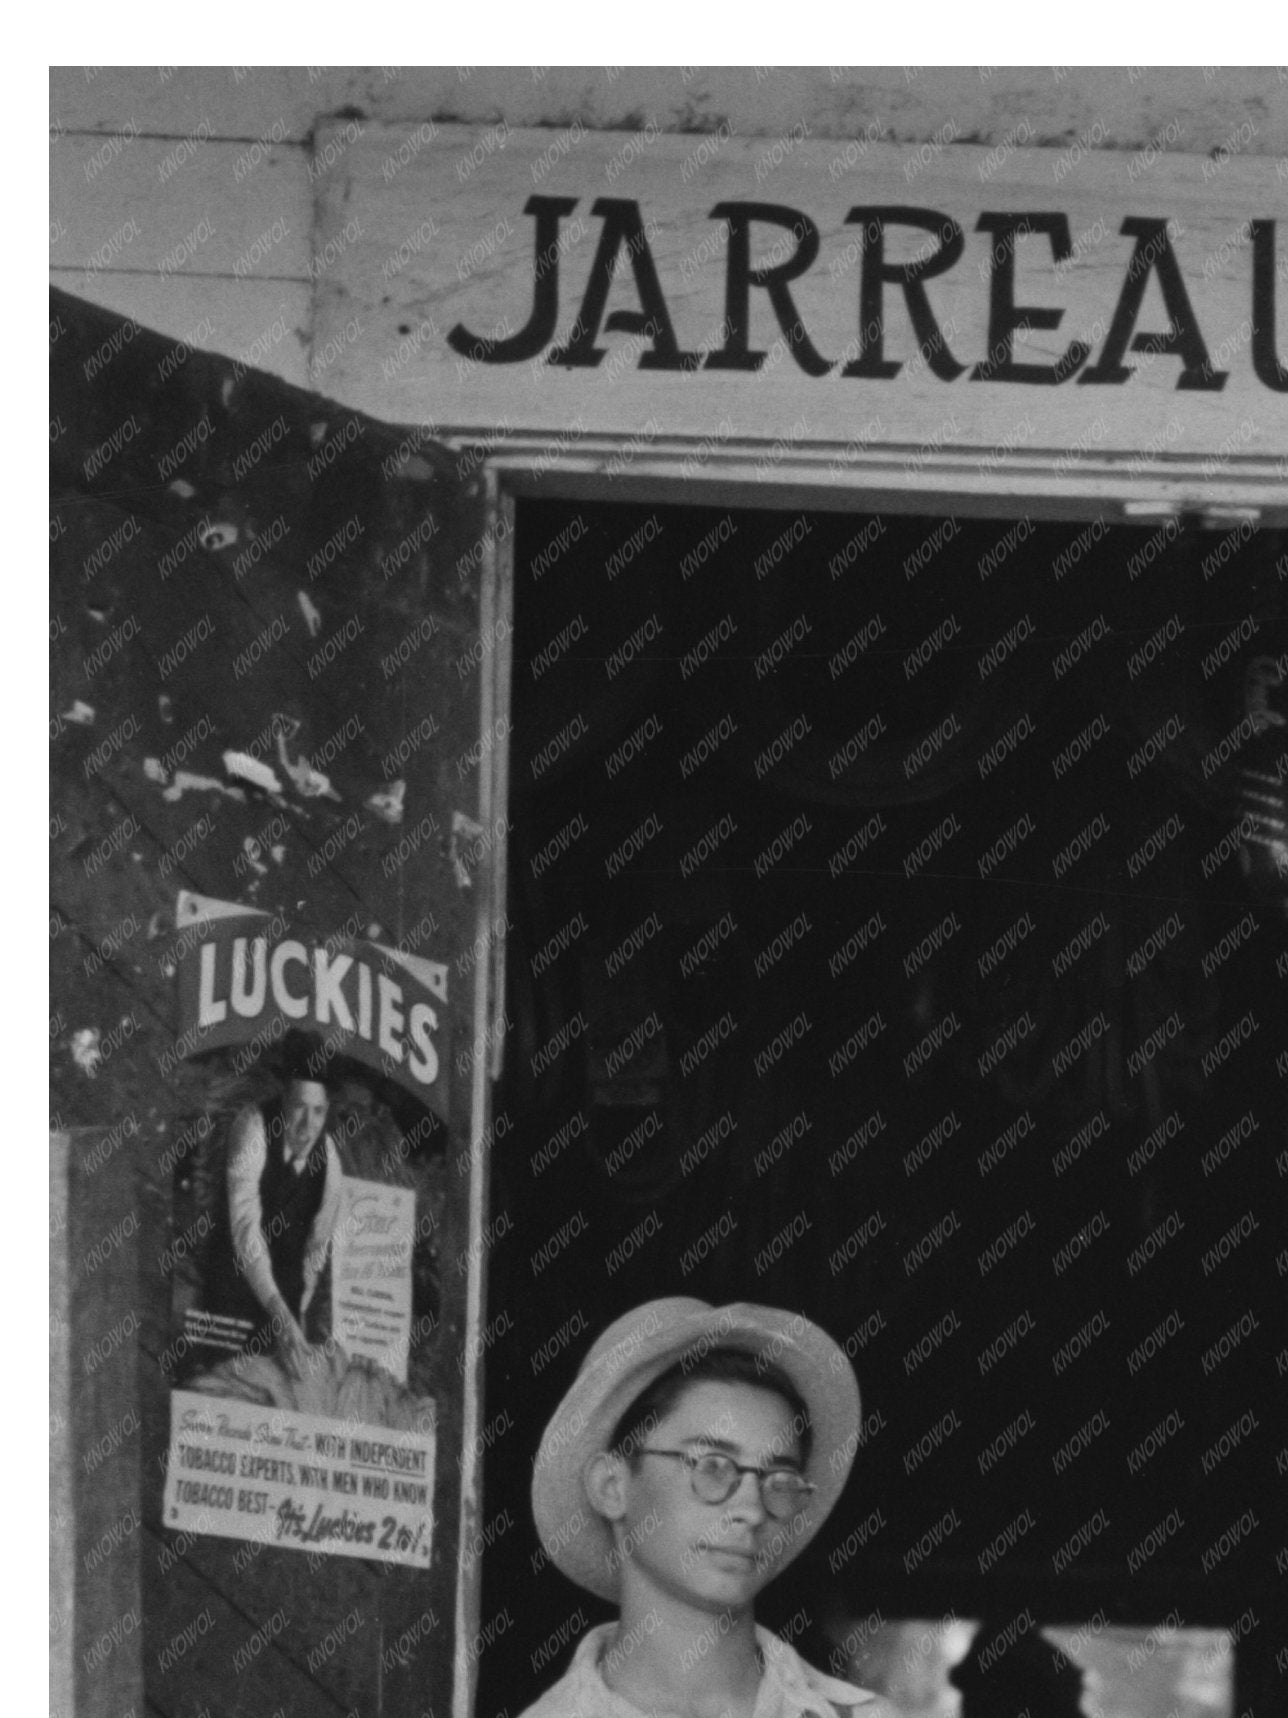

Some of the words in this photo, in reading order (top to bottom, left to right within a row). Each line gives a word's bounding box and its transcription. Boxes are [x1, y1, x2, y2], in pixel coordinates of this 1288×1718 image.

[200, 937, 439, 1085] LUCKIES
[179, 1444, 237, 1475] TOBACCO
[176, 1480, 234, 1511] TOBACCO
